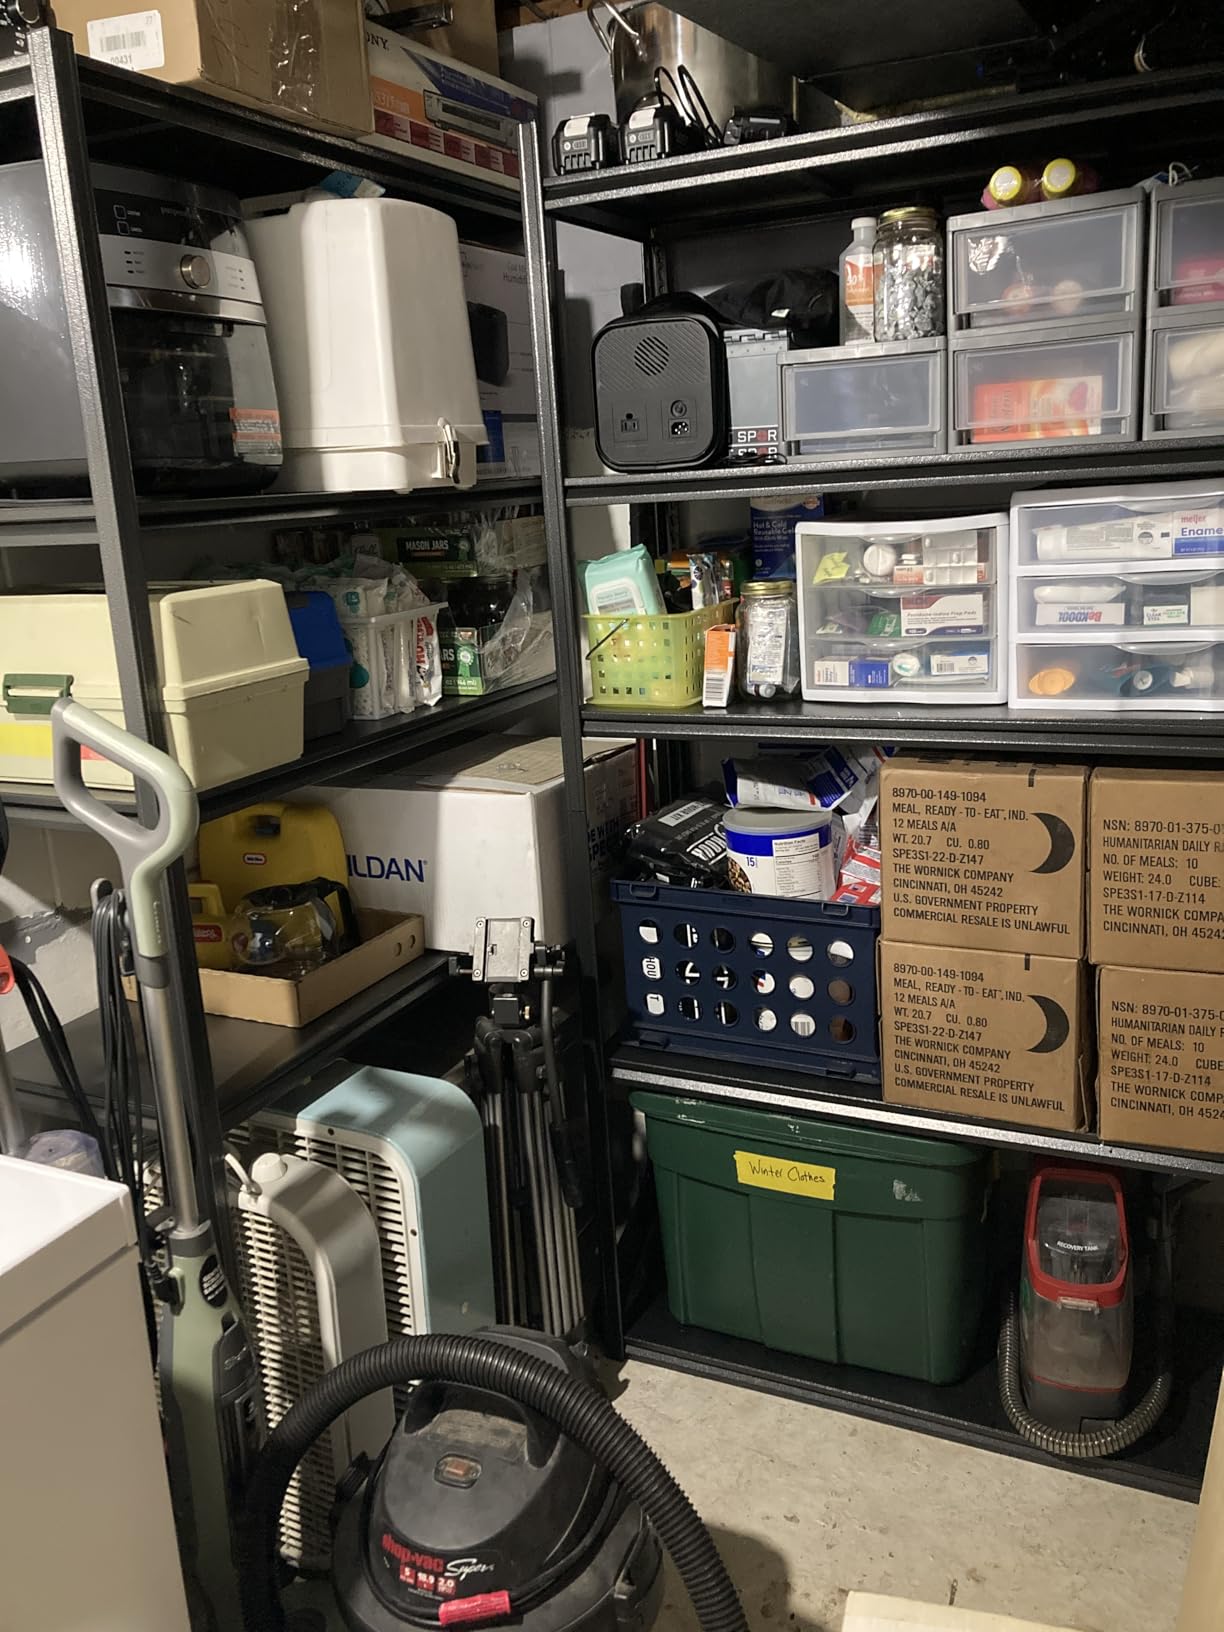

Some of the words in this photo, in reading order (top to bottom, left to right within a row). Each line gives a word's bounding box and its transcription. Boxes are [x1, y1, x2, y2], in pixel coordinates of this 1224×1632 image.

[1181, 514, 1206, 524] meijer
[405, 541, 430, 551] MASON
[431, 540, 449, 550] JARS
[440, 648, 455, 661] RS
[892, 788, 986, 802] 8970-00-149-1094
[892, 803, 920, 816] MEAL,
[925, 805, 957, 816] READY
[965, 807, 976, 817] TO
[1008, 810, 1028, 821] IND.
[893, 818, 903, 828] 12
[907, 820, 938, 831] MEALS
[941, 822, 956, 832] A/A
[1103, 820, 1130, 831] NSN:
[893, 833, 908, 844] WT.
[911, 834, 931, 845] 20.7
[946, 837, 962, 848] CU.
[968, 839, 989, 849] 0.80
[1103, 836, 1178, 850] HUMANITARIAN
[1182, 840, 1210, 852] DAILY
[747, 857, 755, 866] 15
[893, 848, 983, 865] SPE3S1-22-D-Z147
[1103, 854, 1119, 864] NO.
[1123, 855, 1136, 865] OF
[1140, 856, 1178, 868] MEALS:
[1186, 858, 1198, 869] 10
[346, 854, 424, 883] ILDAN
[893, 863, 911, 873] THE
[914, 865, 960, 878] WORNICK
[964, 868, 1014, 882] COMPANY
[893, 878, 950, 894] CINCINNATI,
[954, 884, 967, 894] OH
[971, 885, 1003, 897] 45242
[1103, 871, 1144, 884] WEIGHT:
[1148, 873, 1172, 885] 24.0
[1189, 876, 1221, 888] CUBE:
[1103, 887, 1206, 904] SPE3S1-17-D-Z114
[893, 894, 911, 904] U.S.
[915, 896, 982, 911] GOVERNMENT
[986, 901, 1038, 916] PROPERTY
[1103, 904, 1123, 916] THE
[1127, 906, 1179, 920] WORNICK
[893, 908, 957, 924] COMMERCIAL
[961, 914, 998, 927] RESALE
[1001, 918, 1011, 928] IS
[1015, 920, 1070, 935] UNLAWFUL
[1103, 921, 1168, 937] CINCINNATI,
[1172, 926, 1187, 937] OH
[893, 963, 984, 982] 8970-00-149-1094
[893, 977, 921, 991] MEAL,
[925, 981, 955, 994] READY
[964, 986, 974, 996] TO
[1005, 991, 1024, 1002] IND.
[894, 992, 904, 1002] 12
[907, 995, 937, 1007] MEALS
[940, 999, 955, 1009] A/A
[1112, 1001, 1137, 1014] NSN:
[894, 1006, 909, 1017] WT.
[912, 1009, 931, 1020] 20.7
[946, 1013, 960, 1024] CU.
[967, 1016, 987, 1027] 0.80
[894, 1021, 982, 1041] SPE3S1-22-D-Z147
[1111, 1017, 1185, 1034] HUMANITARIAN
[1189, 1025, 1216, 1036] DAILY
[894, 1035, 911, 1046] THE
[914, 1037, 959, 1053] WORNICK
[963, 1043, 1011, 1060] COMPANY
[1111, 1033, 1126, 1045] NO.
[1131, 1036, 1143, 1046] OF
[1147, 1037, 1184, 1051] MEALS:
[1193, 1042, 1204, 1053] 10
[894, 1049, 949, 1067] CINCINNATI,
[953, 1056, 965, 1067] OH
[969, 1058, 1000, 1073] 45242
[1111, 1049, 1151, 1064] WEIGHT:
[1155, 1055, 1178, 1067] 24.0
[894, 1063, 912, 1075] U.S.
[915, 1066, 979, 1085] GOVERNMENT
[984, 1076, 1034, 1093] PROPERTY
[1111, 1065, 1211, 1086] SPE3S1-17-D-Z114
[895, 1077, 956, 1095] COMMERCIAL
[960, 1087, 996, 1102] RESALE
[999, 1092, 1008, 1103] IS
[1011, 1094, 1065, 1112] UNLAWFUL
[1111, 1081, 1130, 1093] THE
[1134, 1084, 1185, 1099] WORNICK
[1190, 1090, 1224, 1103] COMP
[1111, 1097, 1174, 1116] CINCINNATI,
[1179, 1106, 1193, 1116] OH
[748, 1160, 783, 1177] Winter
[787, 1167, 825, 1182] Clothes
